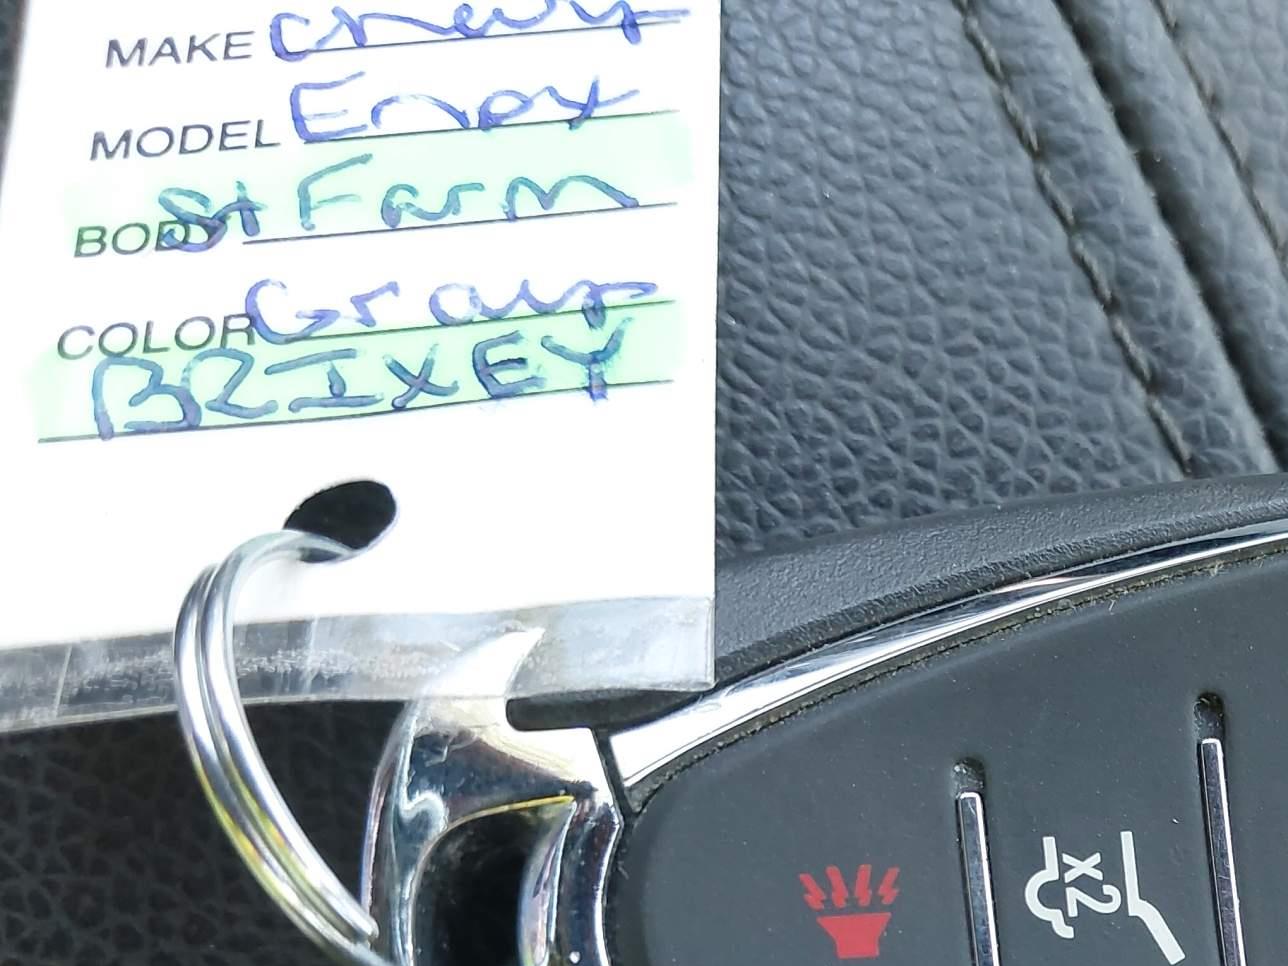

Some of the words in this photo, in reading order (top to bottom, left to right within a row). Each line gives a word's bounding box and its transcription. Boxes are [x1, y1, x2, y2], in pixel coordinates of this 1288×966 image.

[105, 31, 256, 69] MAKE
[89, 119, 281, 162] MODEL
[297, 153, 641, 231] Farm
[57, 312, 256, 360] COLOR
[245, 278, 659, 345] Gray
[92, 317, 634, 441] BRIXEY
